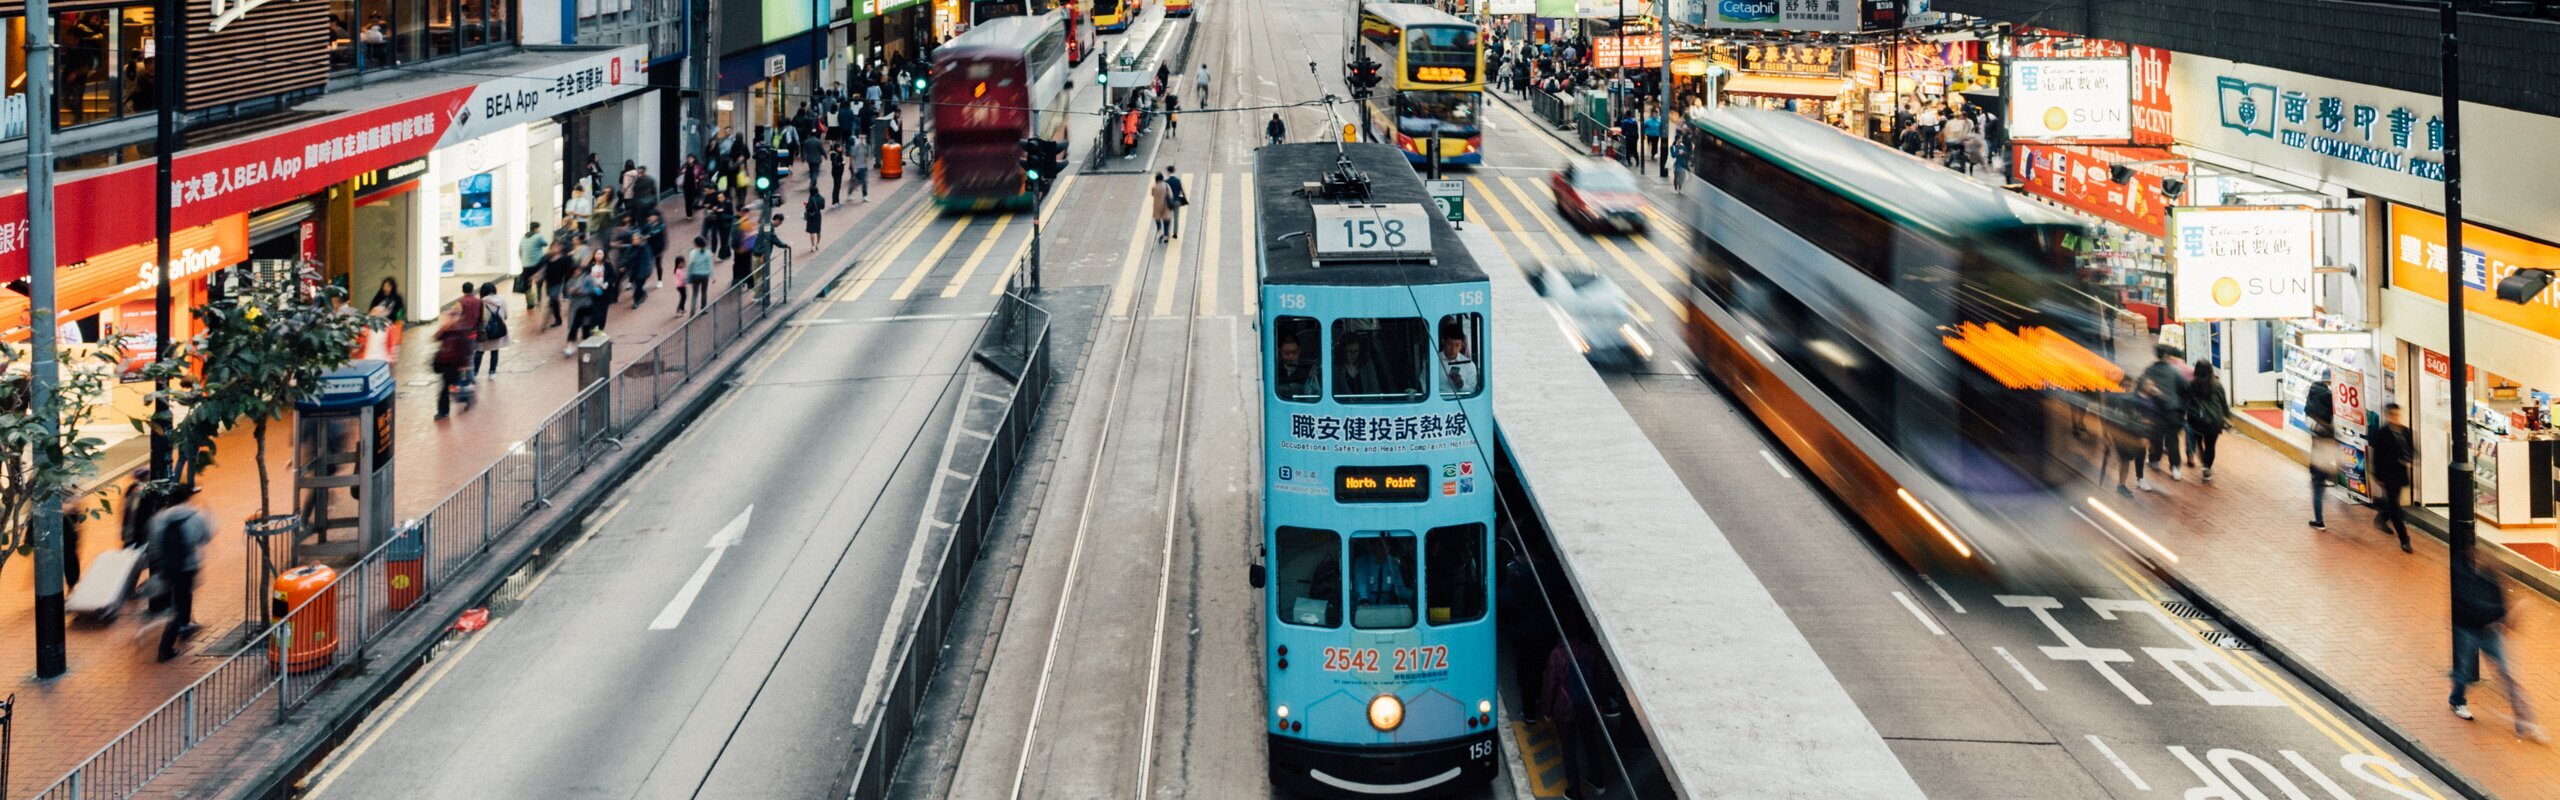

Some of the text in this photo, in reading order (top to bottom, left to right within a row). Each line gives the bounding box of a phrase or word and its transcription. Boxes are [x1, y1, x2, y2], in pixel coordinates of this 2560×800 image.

[1723, 1, 1775, 16] Cetaphil
[545, 66, 603, 99] 一手全面理財
[486, 89, 539, 119] BEA App
[2073, 108, 2121, 123] SUN
[2281, 129, 2445, 182] THE COMMERCIAL PRES
[271, 154, 301, 182] App
[1343, 219, 1407, 249] 158
[2248, 277, 2306, 295] SUN
[1279, 293, 1306, 310] 158
[1458, 290, 1484, 306] 158
[2426, 357, 2448, 375] $400
[2338, 382, 2359, 408] 98
[1292, 412, 1467, 442] 職安健投訴熱線
[1281, 440, 1330, 451] Occupational
[1334, 445, 1360, 453] Safety
[1410, 443, 1447, 452] Complaint
[1450, 440, 1477, 448] Hotline
[1346, 476, 1416, 488] North Point
[1324, 645, 1448, 671] 2542 2172
[1469, 739, 1492, 760] 158
